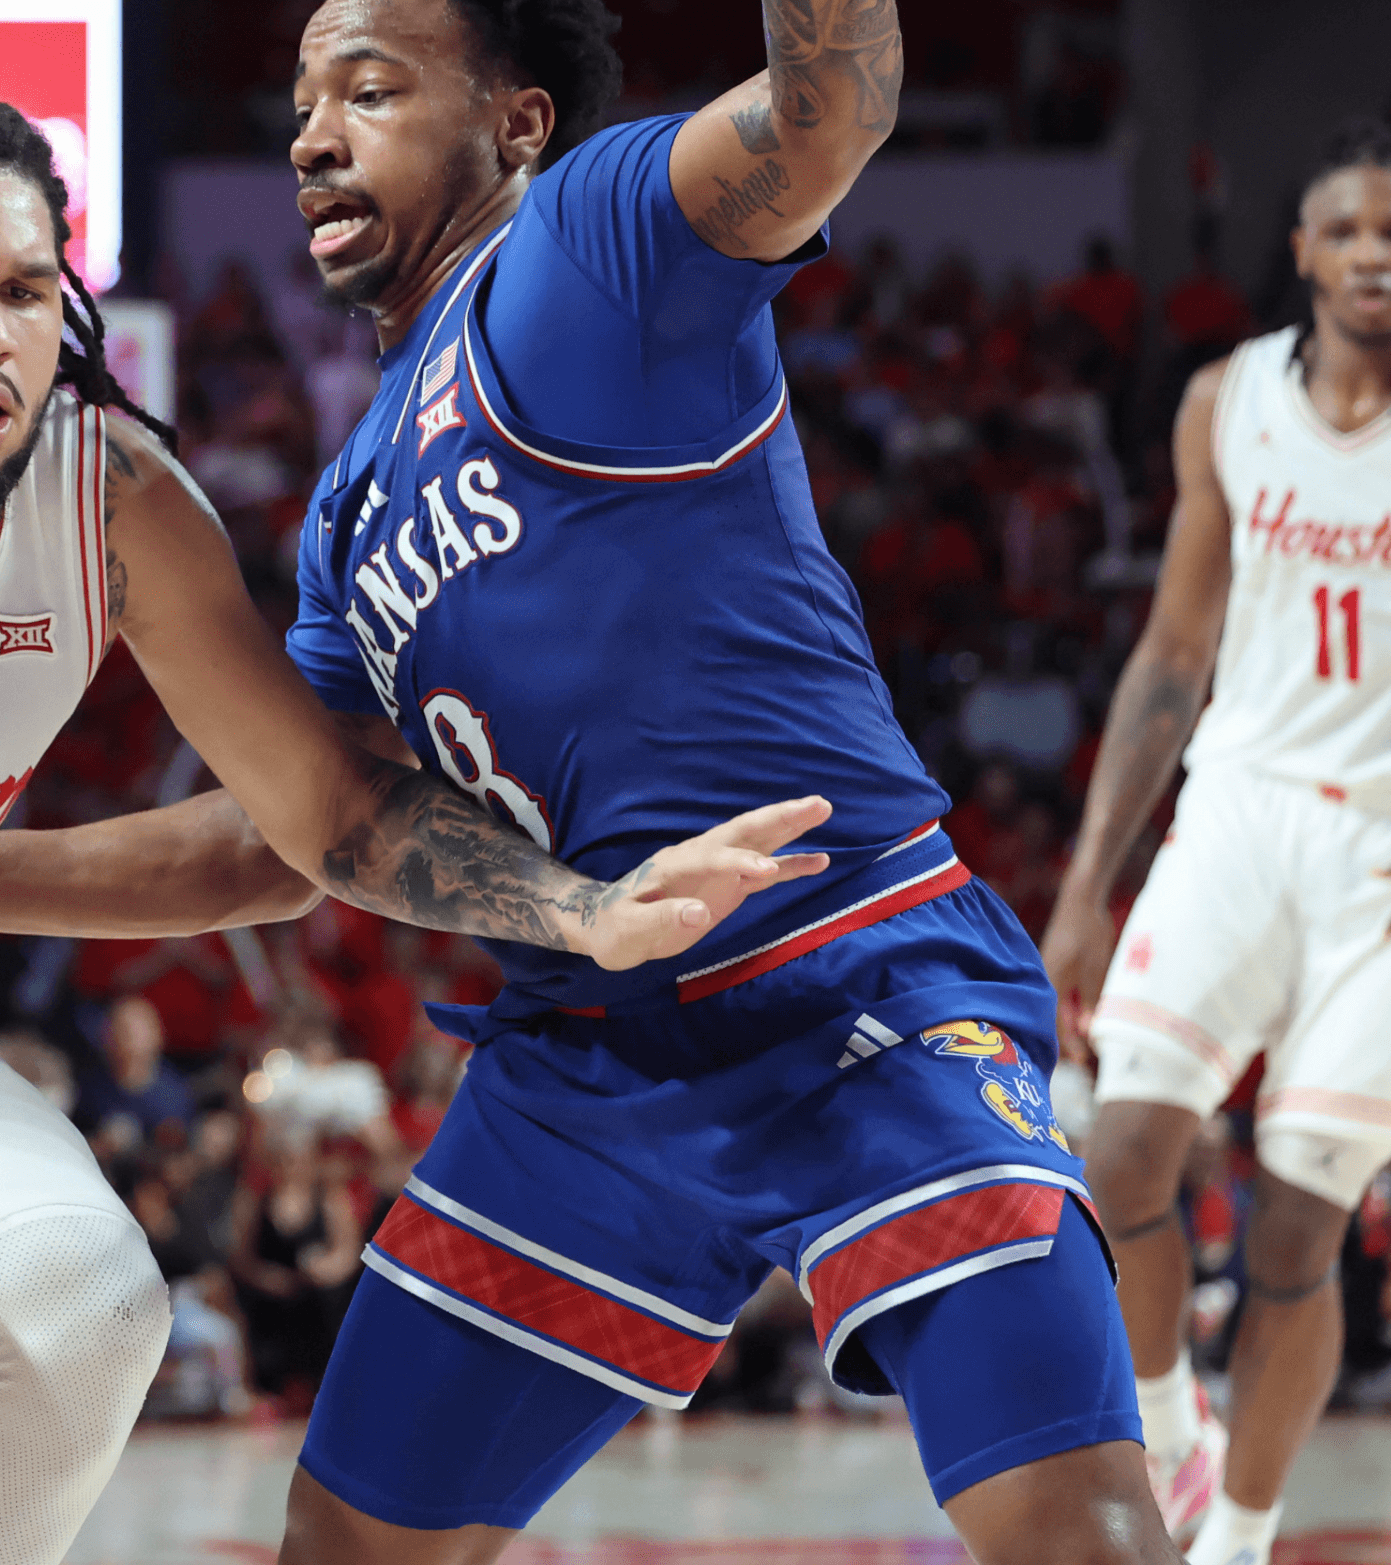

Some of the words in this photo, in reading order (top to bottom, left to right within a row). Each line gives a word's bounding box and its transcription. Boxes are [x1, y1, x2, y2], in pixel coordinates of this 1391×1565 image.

[418, 388, 462, 452] XII
[0, 622, 50, 652] XII
[1313, 582, 1361, 687] 11
